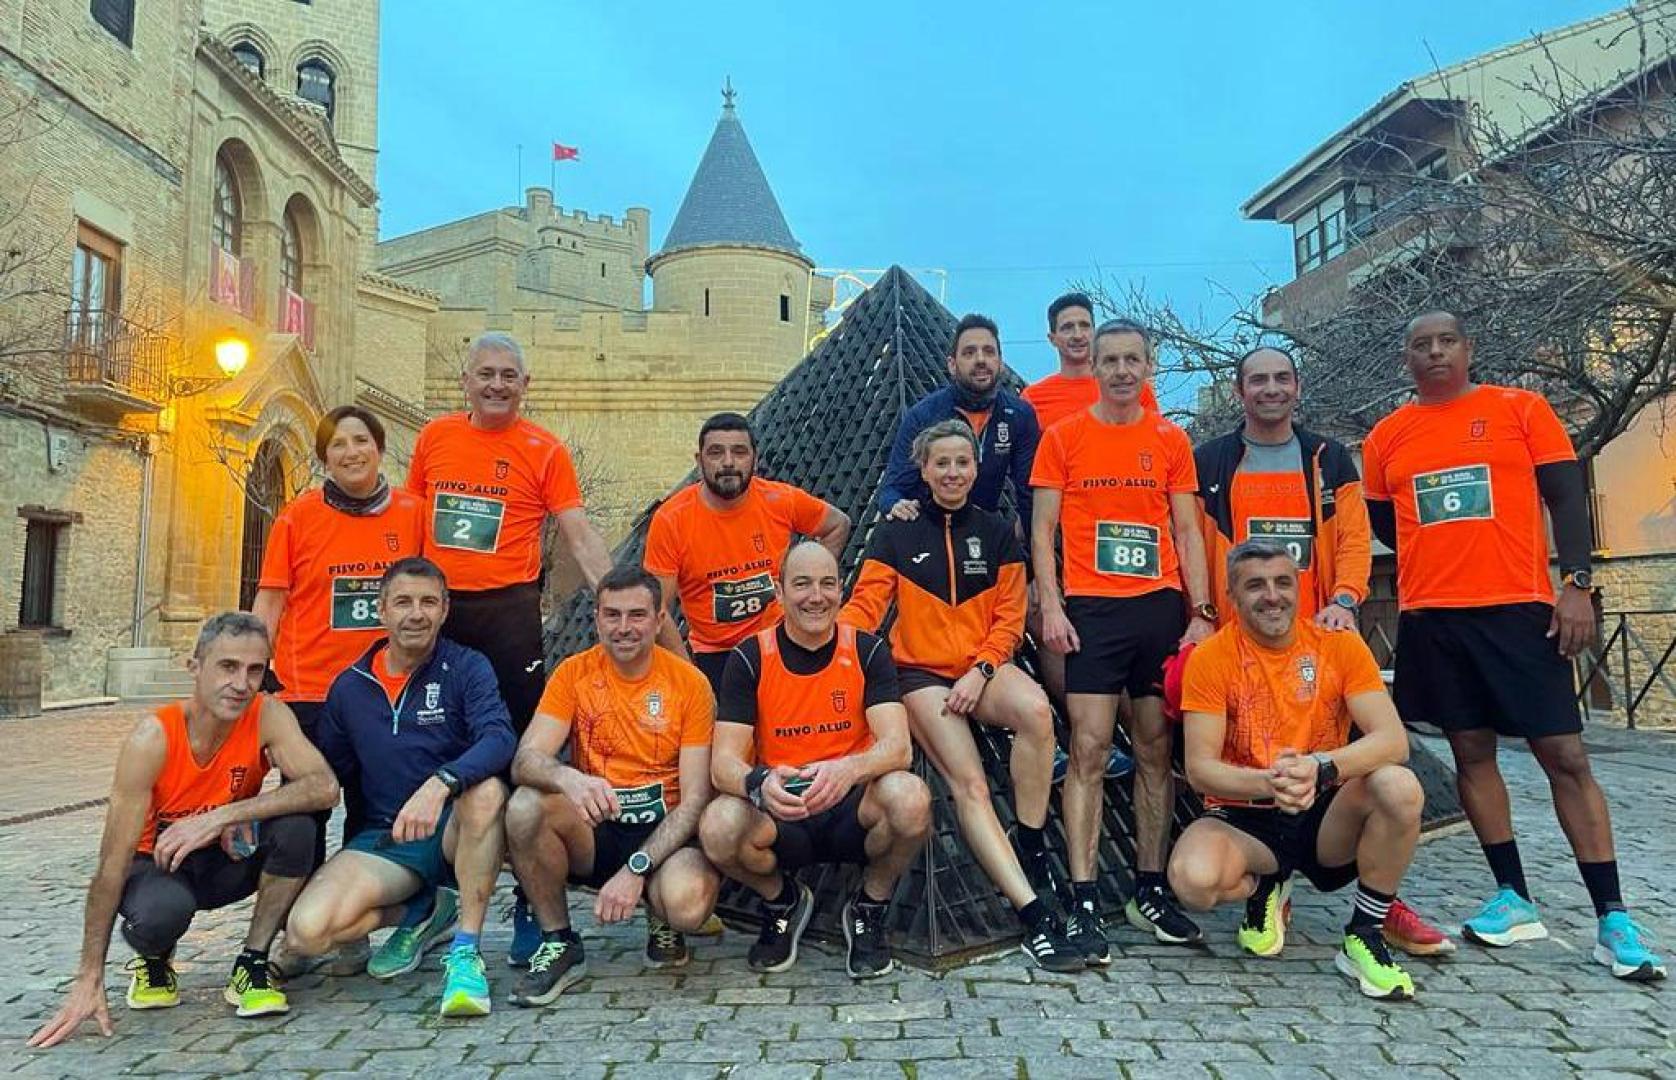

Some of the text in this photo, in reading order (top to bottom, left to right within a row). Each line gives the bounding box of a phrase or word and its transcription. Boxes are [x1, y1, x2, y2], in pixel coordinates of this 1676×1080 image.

[1443, 491, 1461, 512] 6
[452, 518, 473, 540] 2
[1113, 544, 1147, 567] 88
[729, 596, 762, 618] 28
